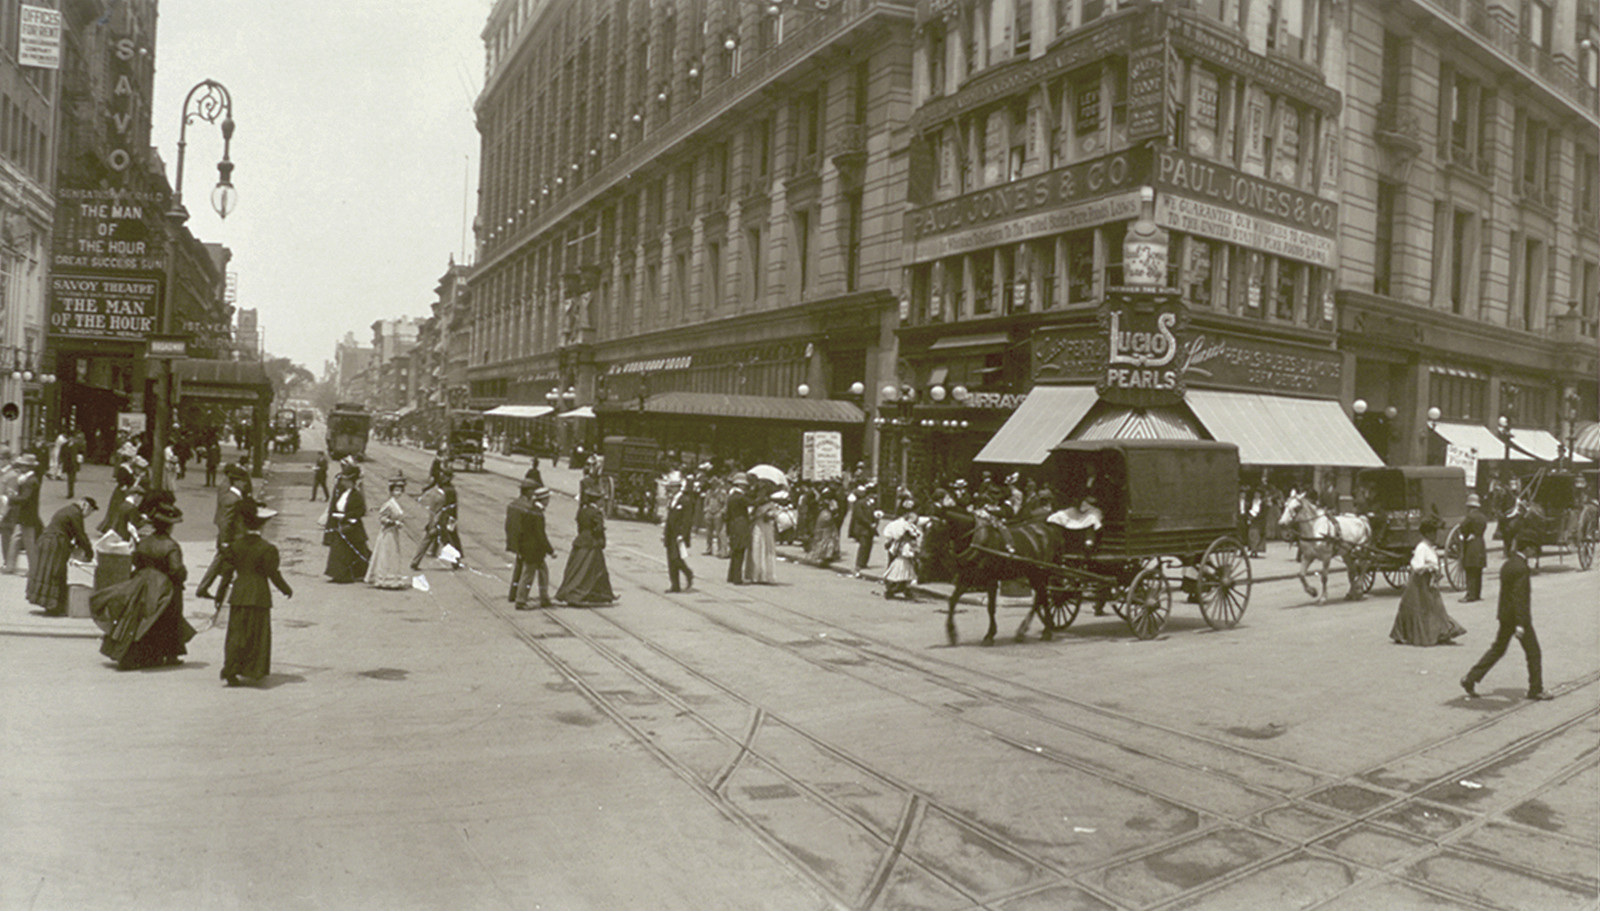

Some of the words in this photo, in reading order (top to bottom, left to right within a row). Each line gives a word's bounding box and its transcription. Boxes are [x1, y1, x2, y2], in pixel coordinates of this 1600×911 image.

[23, 8, 60, 25] OFFICES
[23, 23, 38, 35] FOR
[39, 25, 58, 38] RENT
[912, 204, 962, 238] PAUL
[966, 177, 1049, 222] JONES
[1058, 170, 1076, 199] &
[1086, 156, 1132, 191] CO.
[1158, 153, 1219, 197] PAUL
[1223, 174, 1291, 218] JONES
[1293, 196, 1306, 222] &
[1310, 201, 1334, 231] CO.
[80, 204, 108, 218] THE
[111, 206, 142, 219] MAN
[1110, 199, 1136, 217] Laws
[1179, 198, 1233, 225] GUARANTEE
[1235, 214, 1251, 230] OUR
[98, 223, 118, 236] OF
[1168, 211, 1180, 226] TO
[1181, 214, 1198, 231] THE
[1200, 219, 1231, 238] UNITED
[1232, 226, 1262, 248] STATES
[79, 239, 104, 253] THE
[108, 241, 146, 254] HOUR
[55, 255, 88, 265] GREAT
[91, 257, 137, 269] SUCCESS
[53, 280, 99, 291] SAVOY
[102, 282, 155, 294] THEATRE
[105, 300, 145, 315] MAN
[51, 313, 71, 326] OF
[74, 313, 106, 328] THE
[1107, 368, 1177, 389] PEARLS
